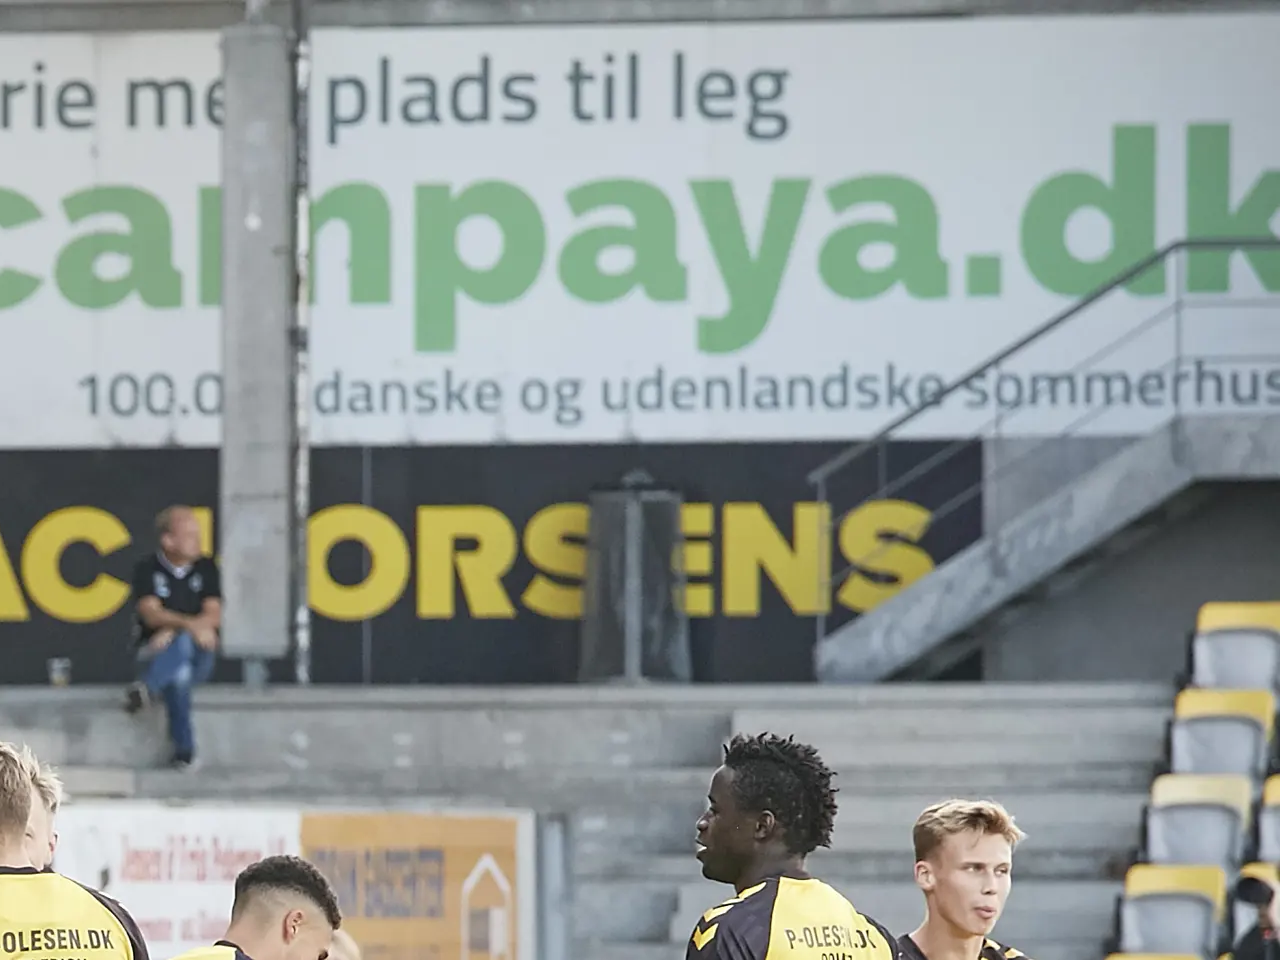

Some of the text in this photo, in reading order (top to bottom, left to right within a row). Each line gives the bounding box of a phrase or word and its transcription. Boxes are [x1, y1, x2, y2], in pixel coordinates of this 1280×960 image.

[326, 54, 539, 146] plads
[565, 52, 639, 122] til
[672, 51, 791, 141] leg
[78, 372, 224, 418] 100.0
[313, 367, 504, 416] danske
[519, 373, 585, 427] og
[601, 361, 946, 413] udenlandske
